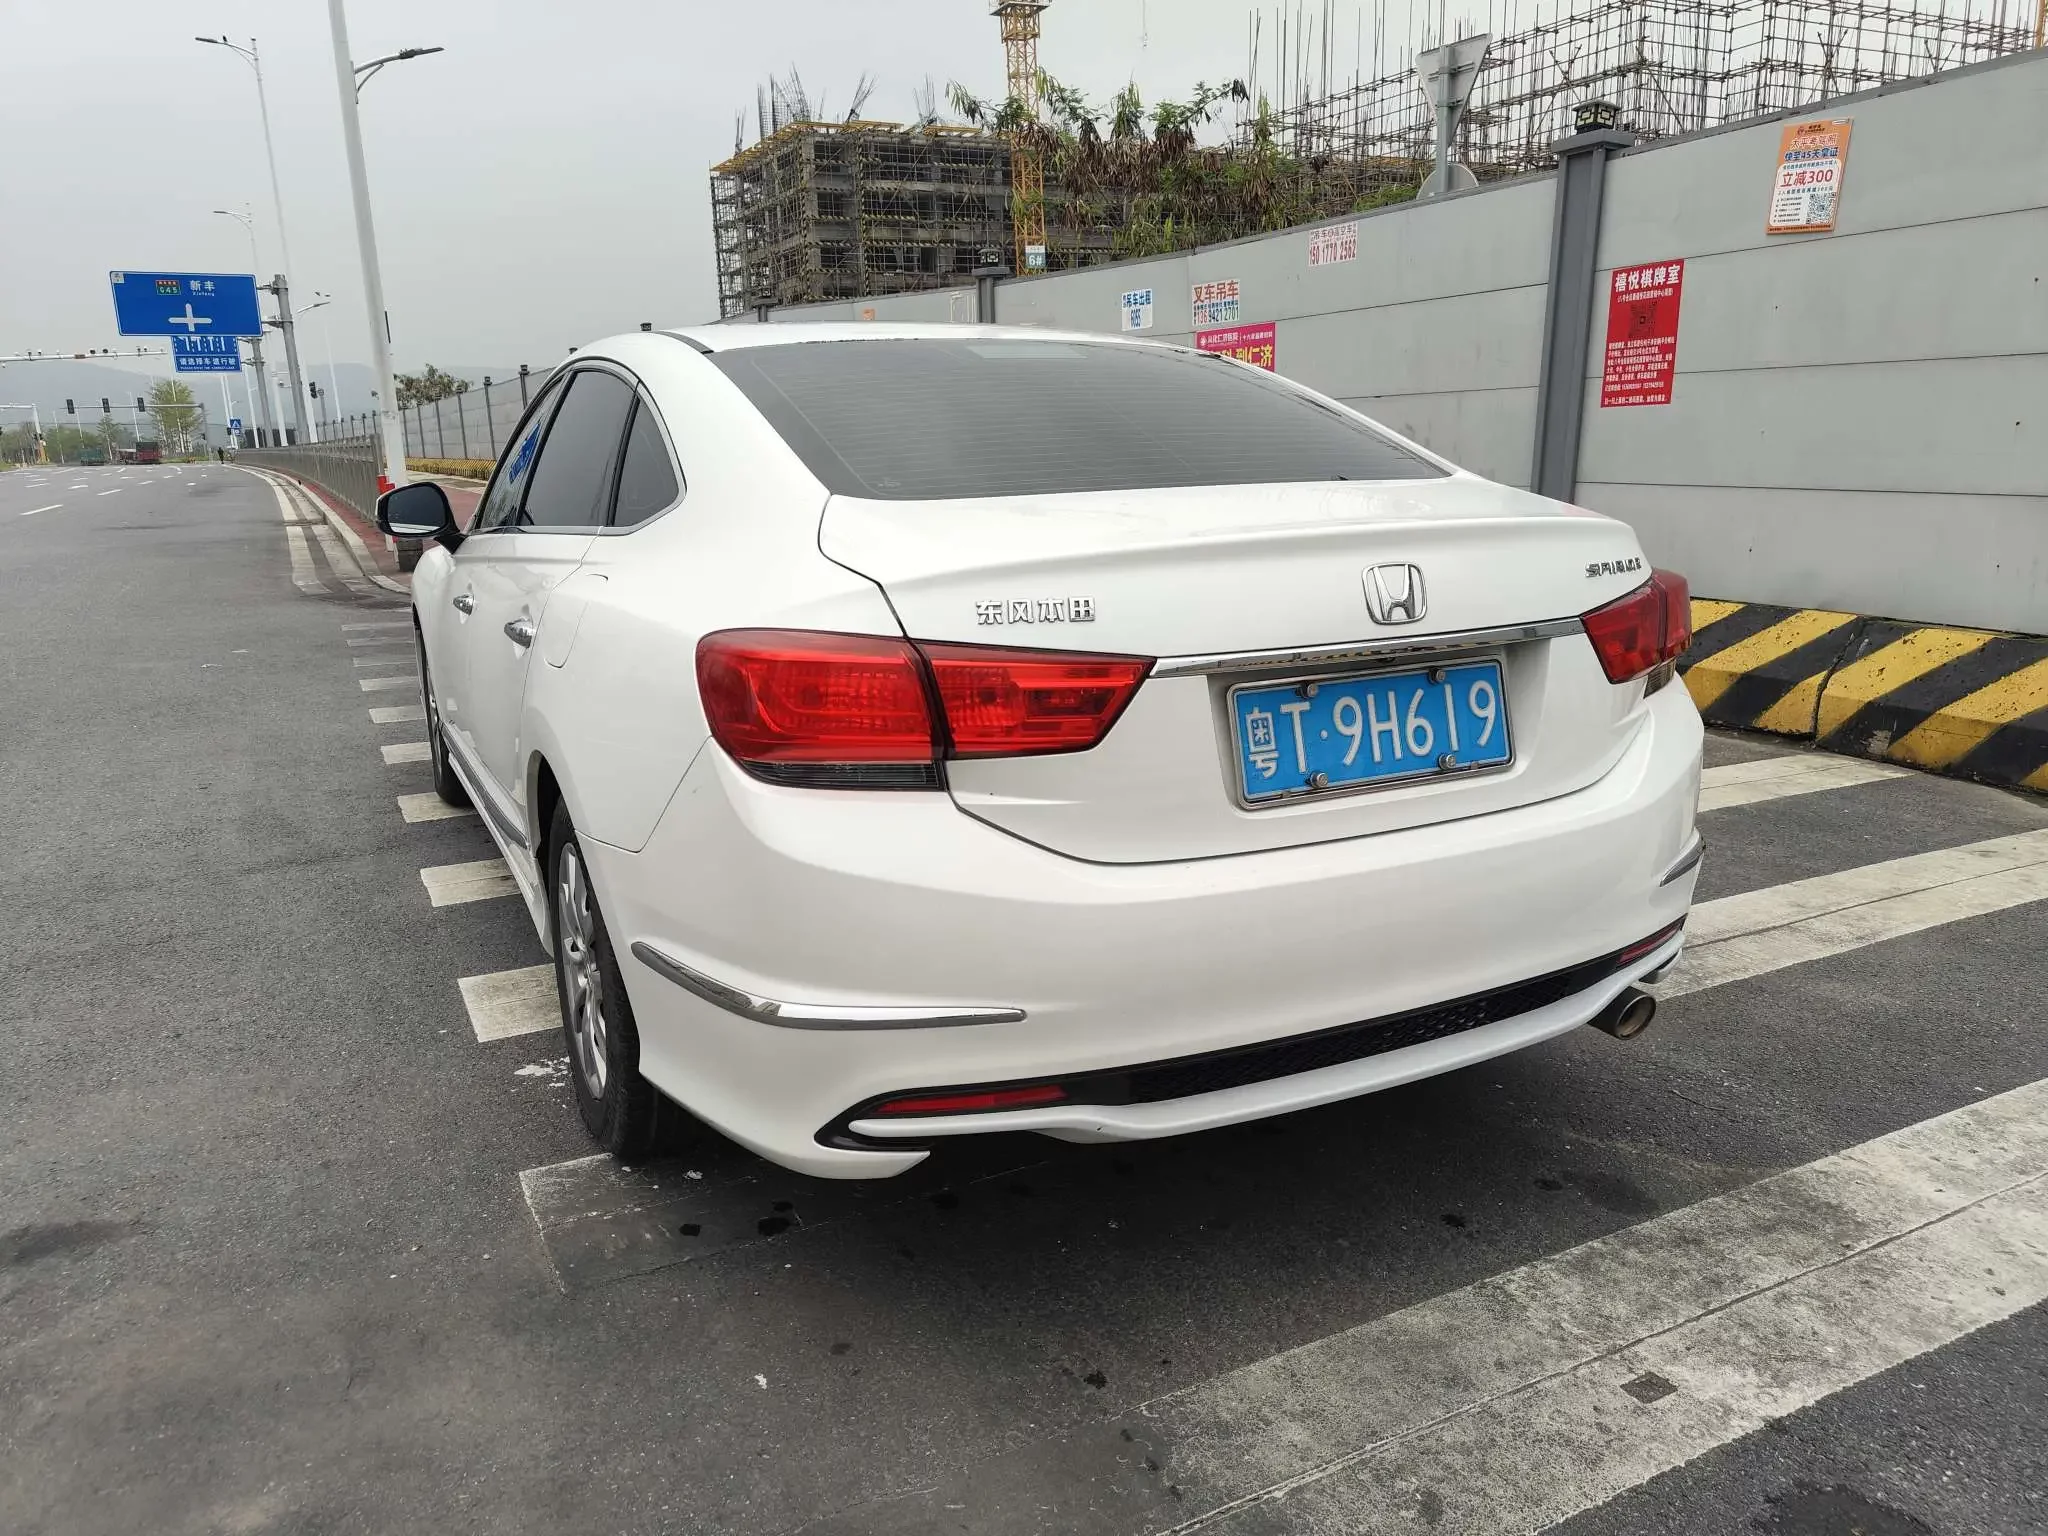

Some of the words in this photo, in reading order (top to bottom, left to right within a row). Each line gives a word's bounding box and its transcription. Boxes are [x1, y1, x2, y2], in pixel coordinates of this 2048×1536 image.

[1780, 169, 1833, 187] 立减300
[1029, 255, 1042, 266] 6#
[189, 280, 215, 292] 新丰
[1615, 264, 1680, 292] 禧悦棋牌室
[1193, 279, 1239, 304] 叉车吊车
[976, 597, 1095, 625] 东风本田
